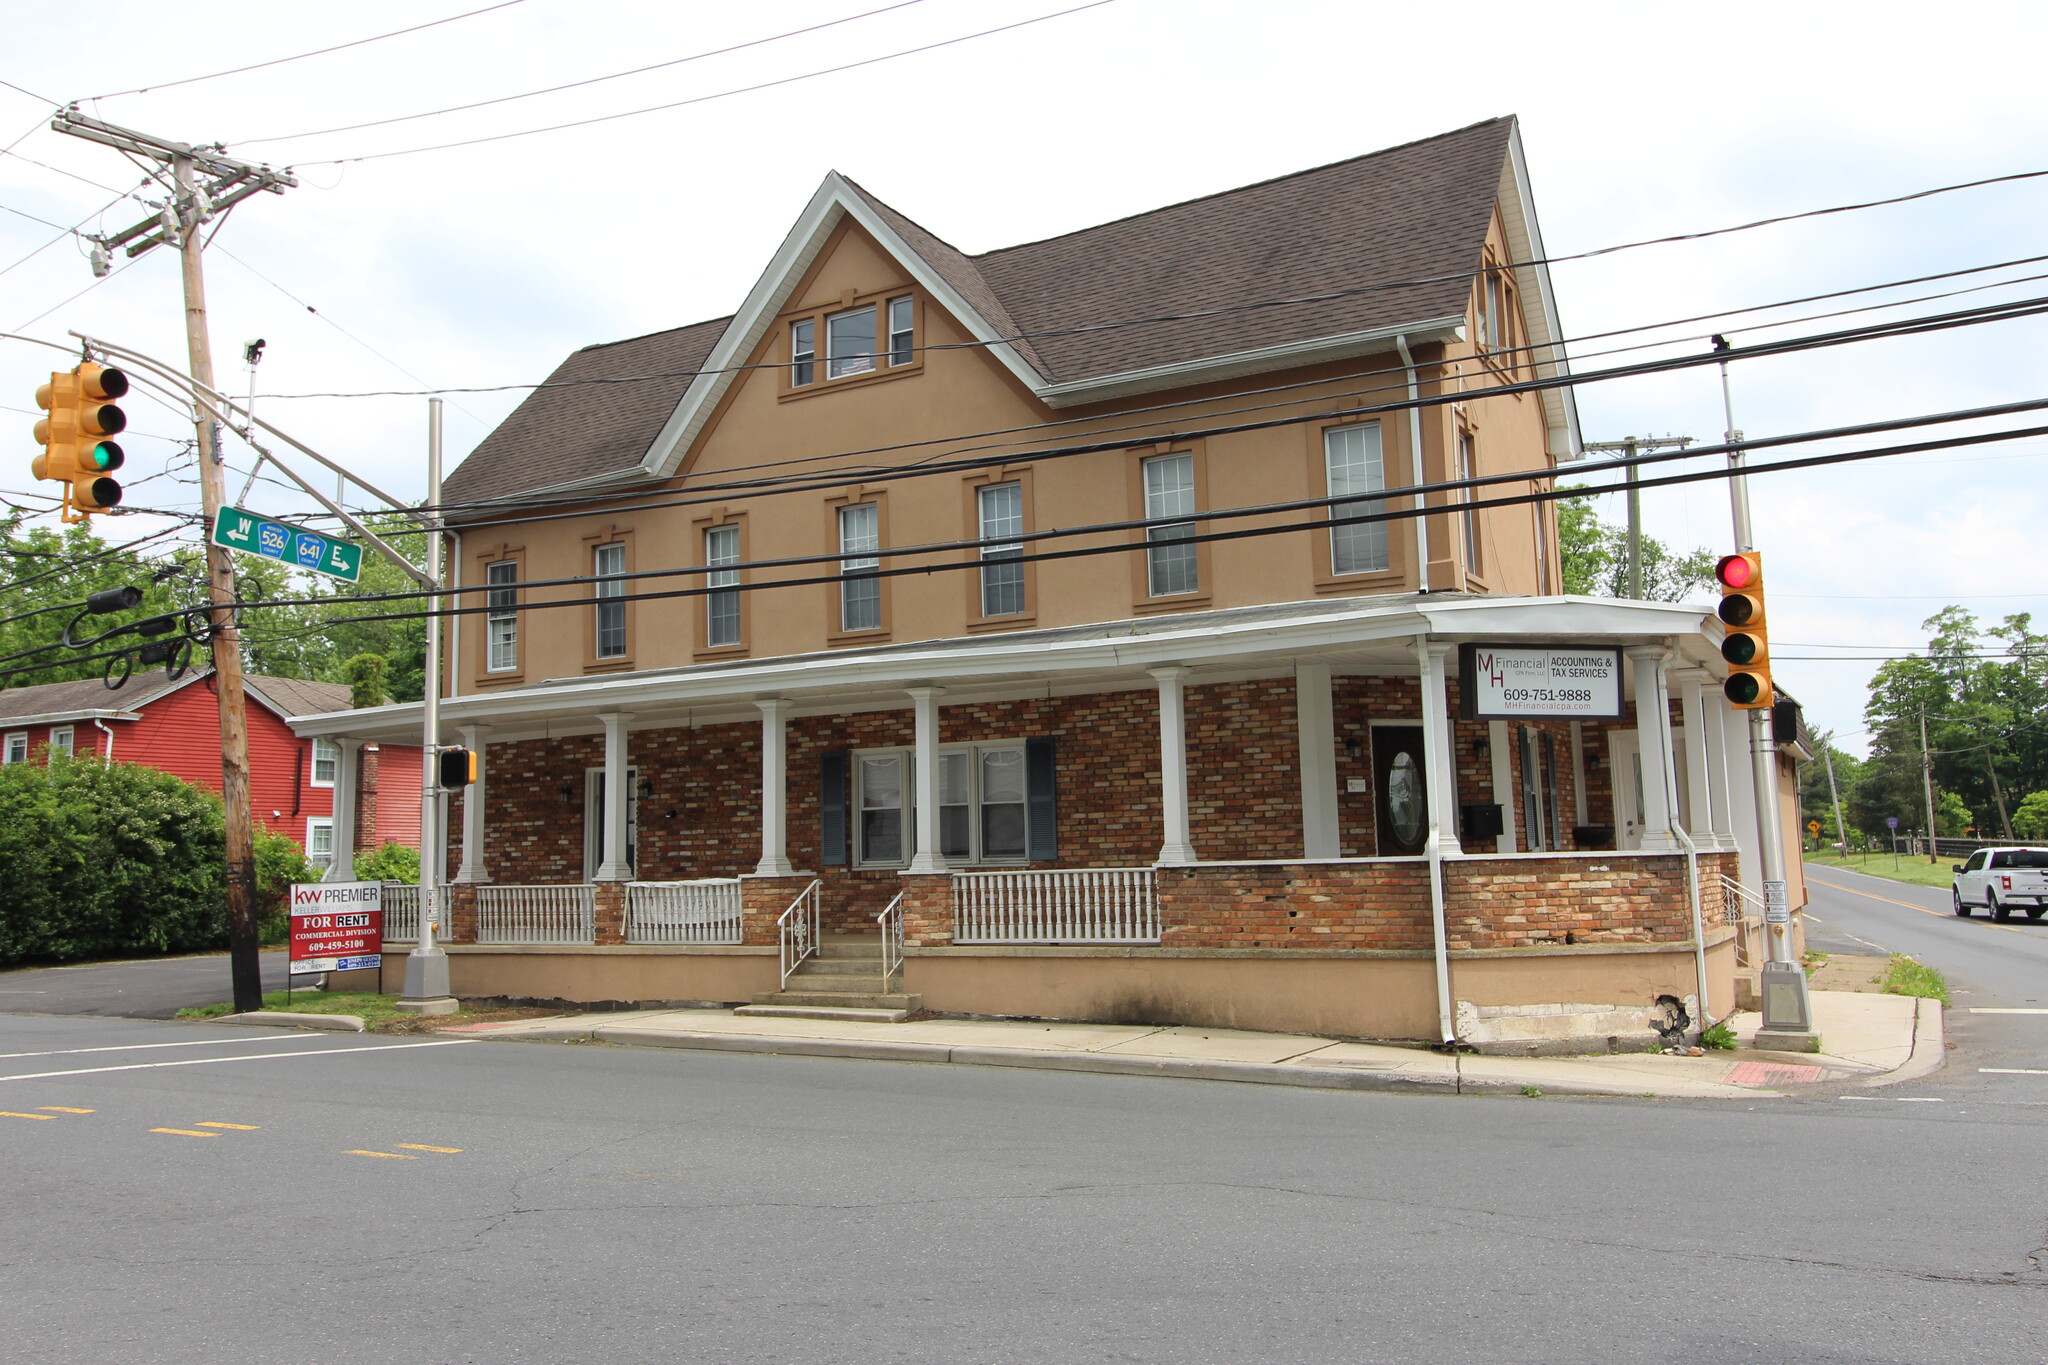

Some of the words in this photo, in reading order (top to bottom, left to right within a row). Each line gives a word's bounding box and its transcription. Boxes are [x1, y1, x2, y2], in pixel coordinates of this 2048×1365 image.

[239, 517, 252, 535] W
[266, 525, 283, 533] MERCER
[261, 530, 285, 550] 526
[304, 536, 320, 544] MERCER
[299, 542, 320, 560] 641
[332, 545, 342, 561] E
[300, 557, 316, 565] COUNTY
[1495, 657, 1546, 669] Financial
[1551, 657, 1603, 668] ACCOUNTING
[1605, 658, 1613, 667] &
[1551, 668, 1567, 678] TAX
[1569, 668, 1608, 678] SERVICES
[1503, 688, 1592, 701] 609-751-9888
[1504, 702, 1591, 711] MHFinancialcpa.com
[324, 887, 378, 904] PREMIER
[303, 916, 332, 929] FOR
[337, 914, 368, 927] RENT
[295, 931, 344, 940] COMMERCIAL
[345, 928, 377, 937] DIVISION
[308, 940, 364, 952] 609-459-5100
